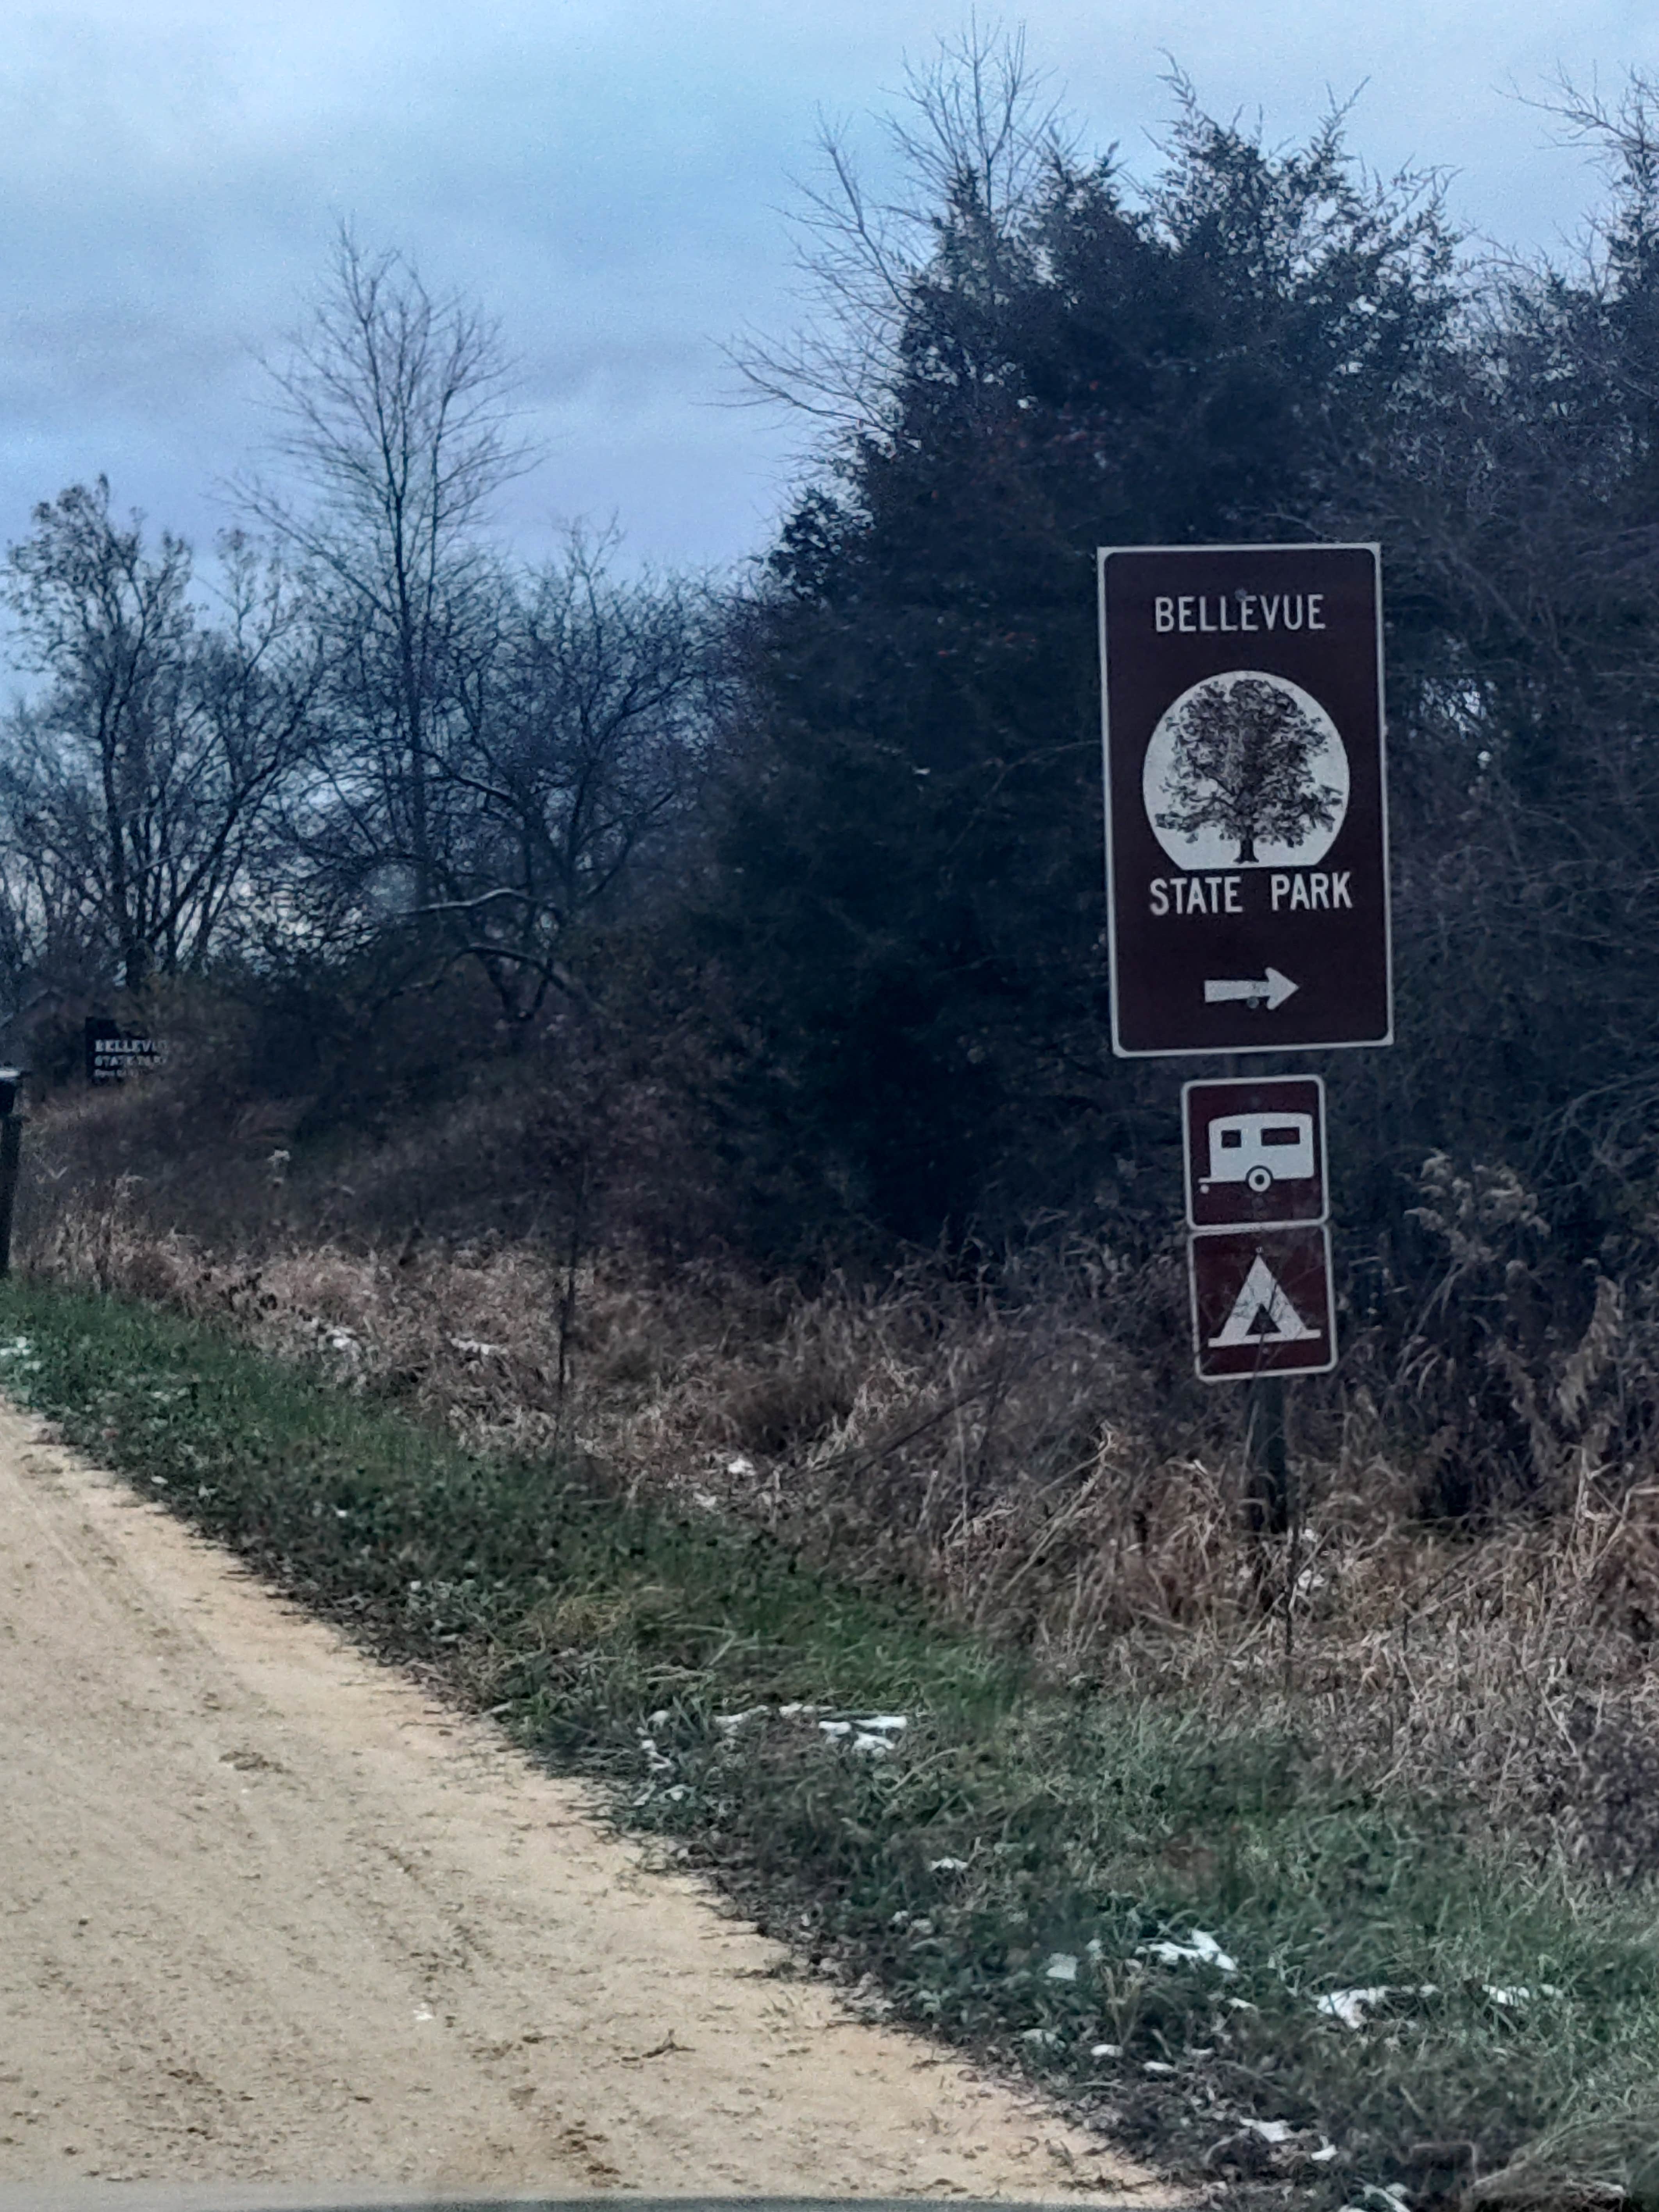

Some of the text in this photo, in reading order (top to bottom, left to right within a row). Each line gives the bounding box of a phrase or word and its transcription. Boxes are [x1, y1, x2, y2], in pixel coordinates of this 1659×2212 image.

[1154, 593, 1326, 633] BELLEVUE
[1149, 871, 1353, 916] STATE PARK
